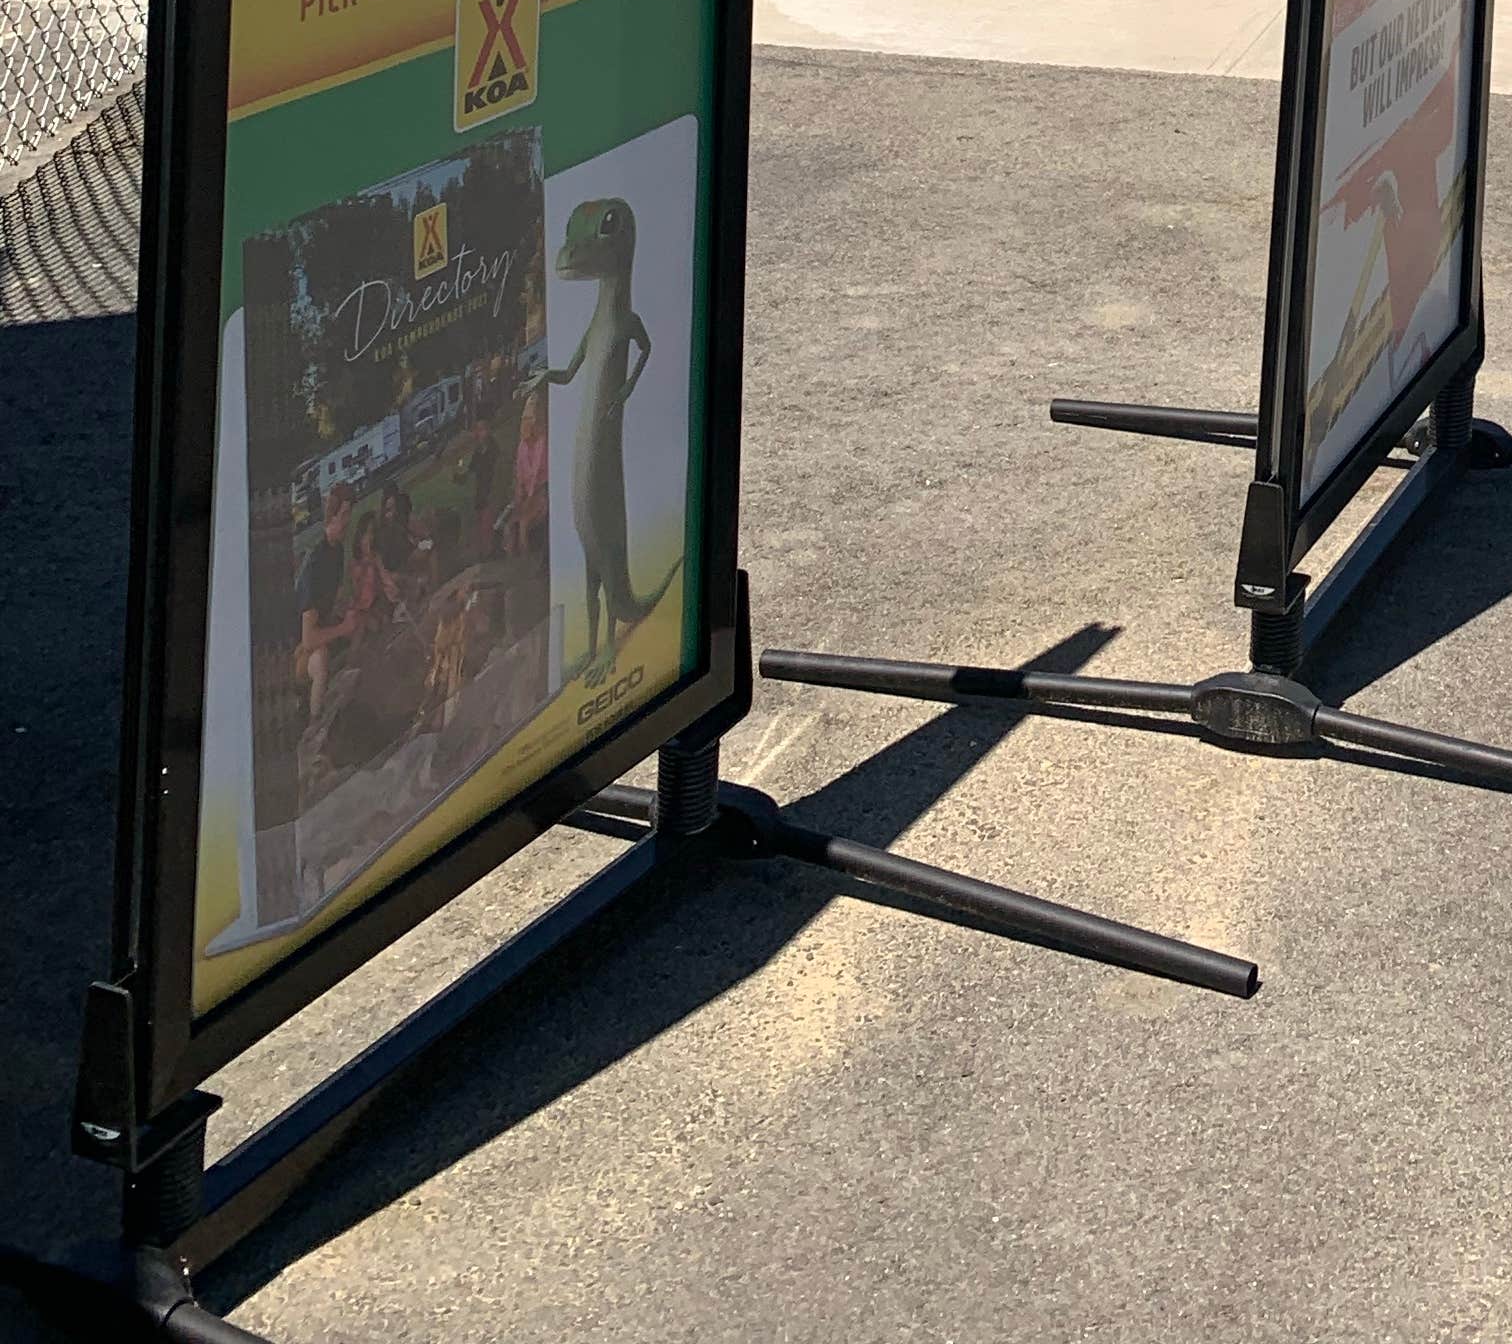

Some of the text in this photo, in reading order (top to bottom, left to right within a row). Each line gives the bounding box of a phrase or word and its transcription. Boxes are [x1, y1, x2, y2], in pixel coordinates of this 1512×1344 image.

[1351, 33, 1377, 91] BUT
[1379, 12, 1404, 69] OUR
[463, 70, 530, 114] KOA
[1362, 66, 1392, 129] WILL
[418, 251, 445, 271] KOA
[334, 243, 518, 362] Directory
[576, 663, 645, 726] GEICO
